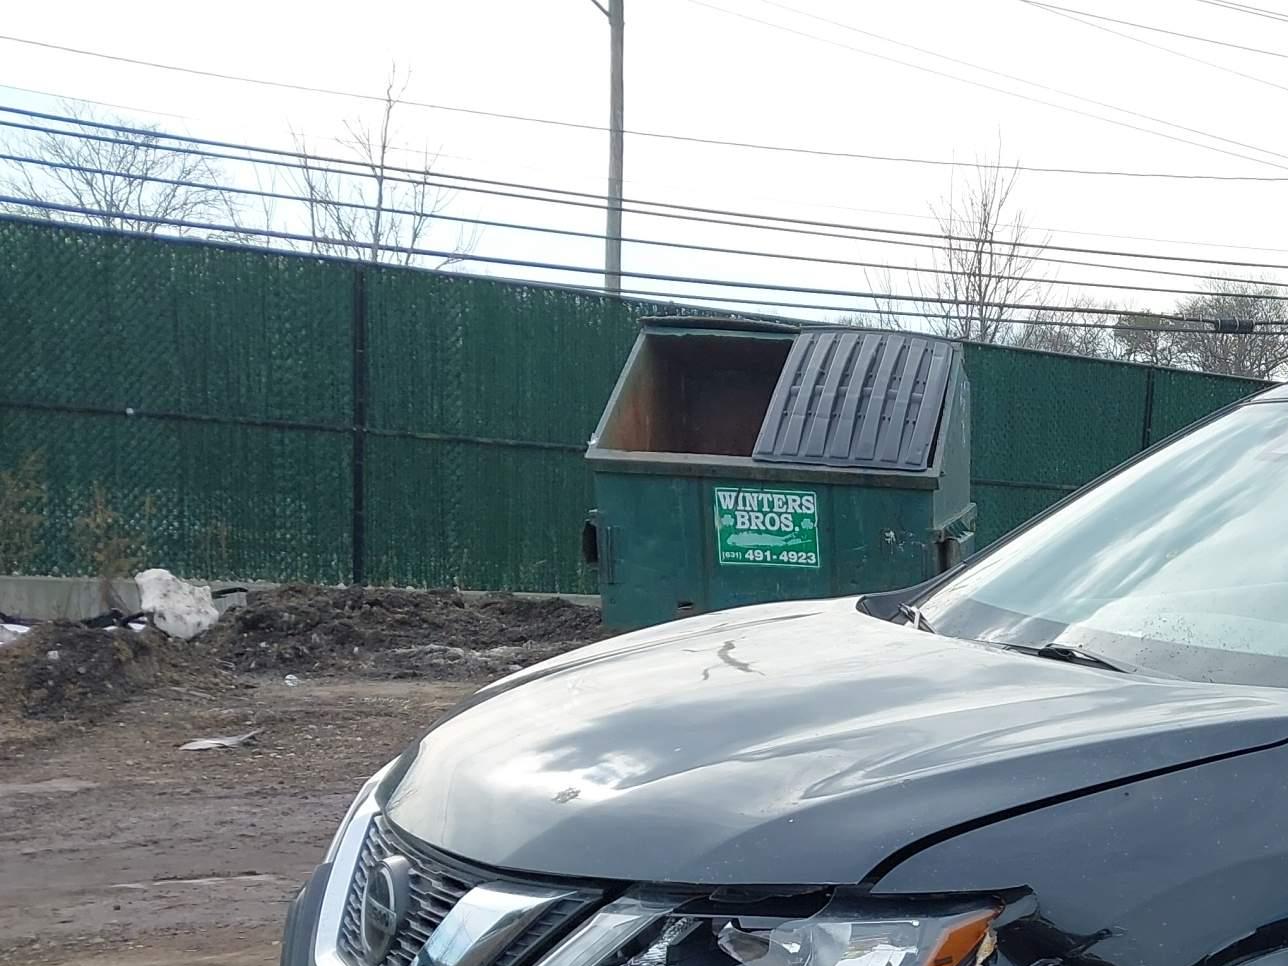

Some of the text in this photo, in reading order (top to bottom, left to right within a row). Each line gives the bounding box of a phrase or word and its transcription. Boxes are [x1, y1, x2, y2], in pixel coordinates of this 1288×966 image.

[717, 491, 815, 514] WINTERS
[735, 511, 800, 532] BROS.
[745, 549, 817, 564] 491-4923
